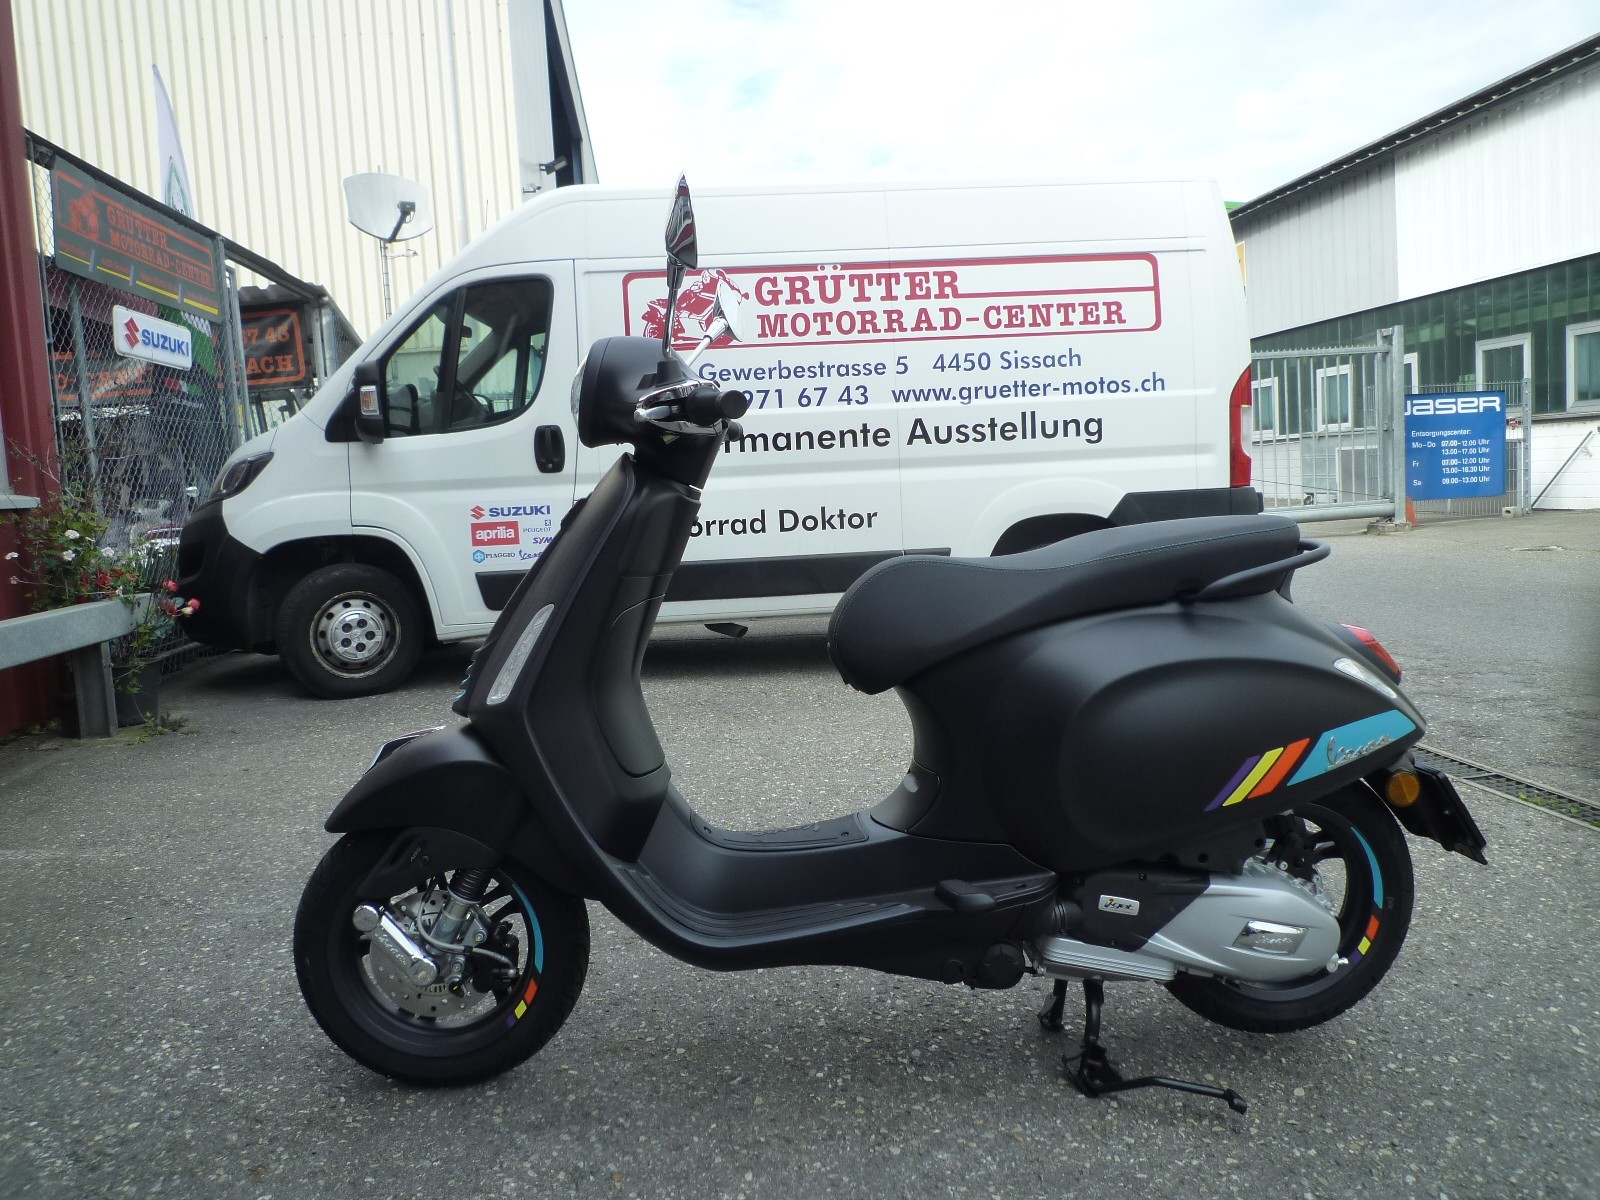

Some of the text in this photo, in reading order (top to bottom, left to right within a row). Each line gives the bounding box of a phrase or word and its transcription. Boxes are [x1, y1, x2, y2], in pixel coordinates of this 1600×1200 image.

[755, 265, 959, 306] GRÜTTER
[757, 301, 1126, 338] MOTORRAD-CENTER
[141, 328, 189, 357] SUZUKI
[699, 348, 1082, 382] Gewerbestrasse 5 4450 Sissach
[798, 387, 828, 408] 67
[838, 385, 869, 406] 43
[891, 371, 1166, 405] www.gruetter-motos.ch
[906, 411, 1103, 444] Ausstellung
[1478, 446, 1490, 454] Uhr
[1478, 475, 1491, 483] Uhr
[488, 505, 551, 518] SUZUKI
[778, 506, 879, 532] Doktor
[475, 526, 516, 542] aprilia
